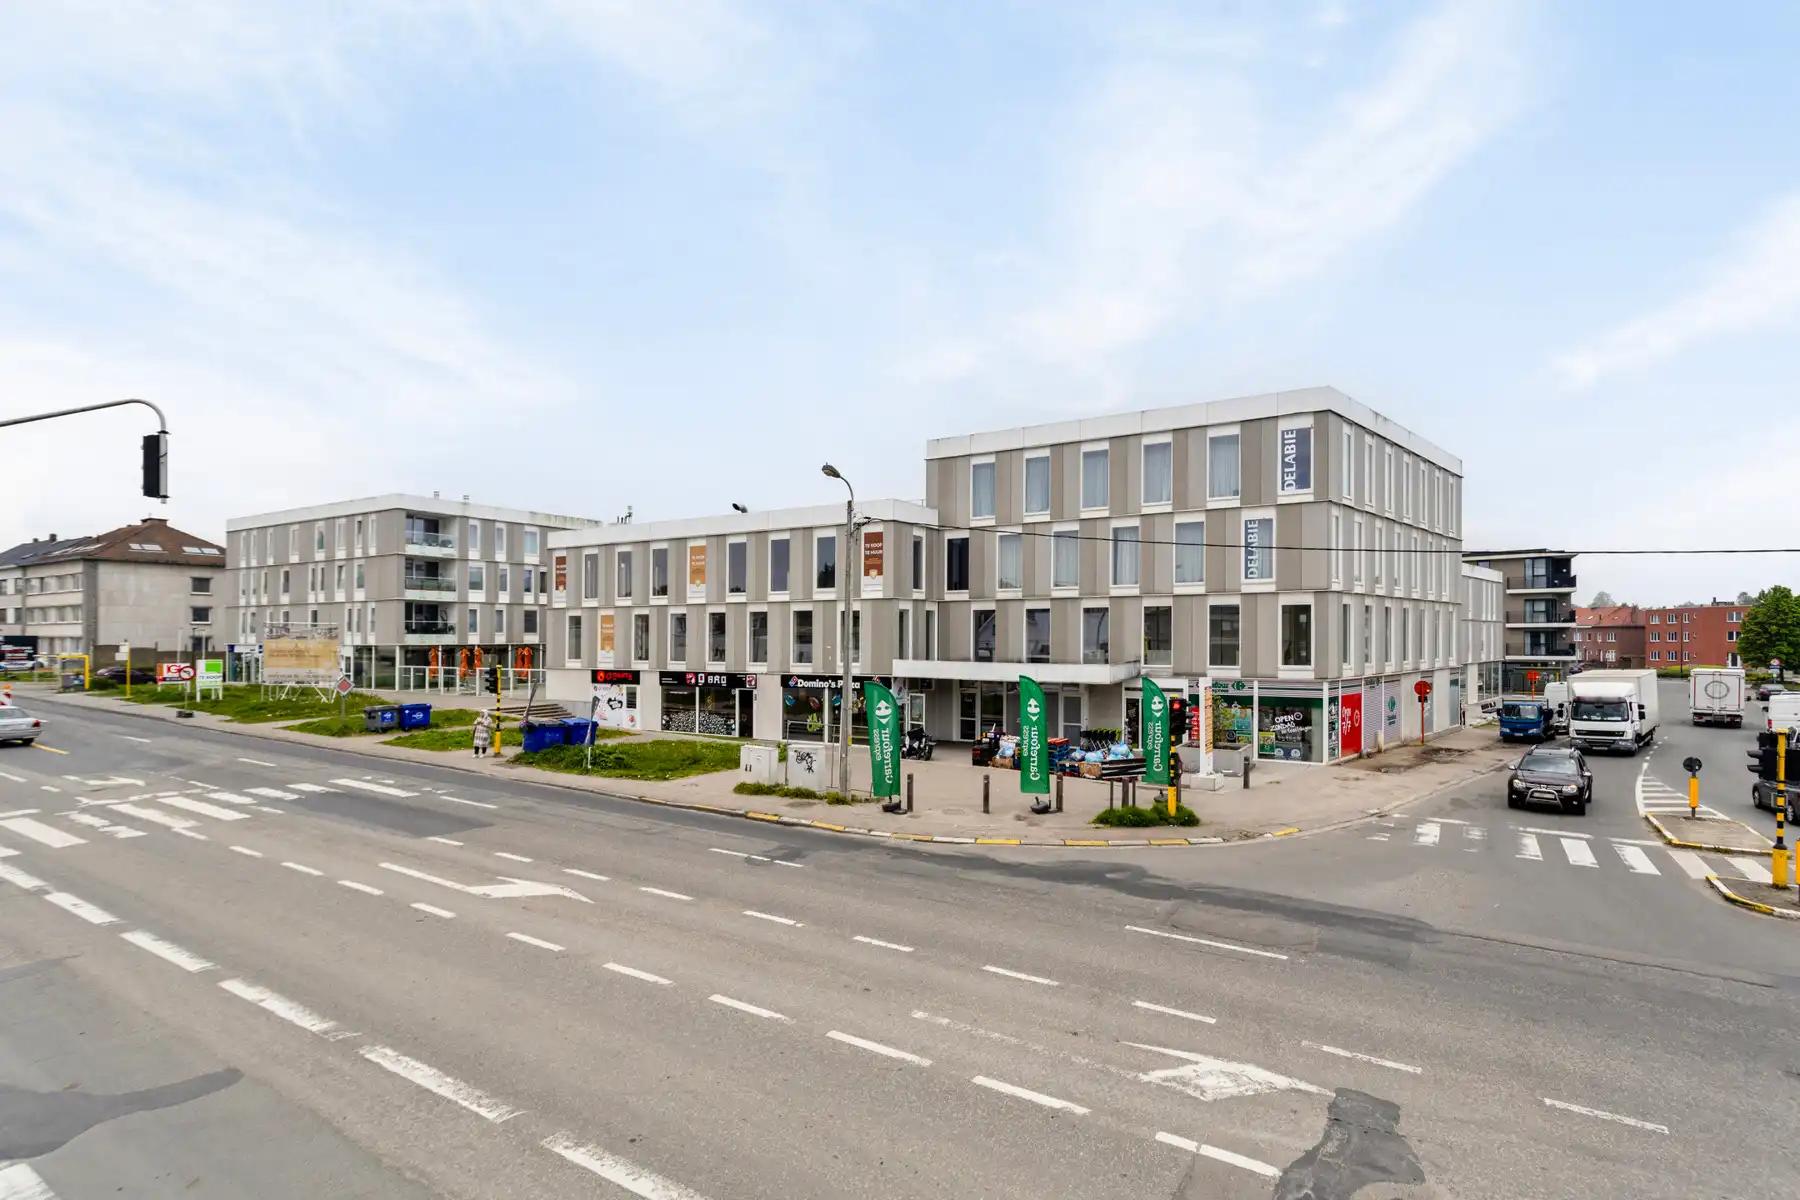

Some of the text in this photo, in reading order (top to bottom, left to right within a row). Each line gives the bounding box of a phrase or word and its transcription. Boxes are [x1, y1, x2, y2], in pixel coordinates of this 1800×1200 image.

[1284, 430, 1296, 491] DELABIE
[1247, 520, 1259, 578] DELABIE
[797, 679, 836, 689] Domino's
[1275, 714, 1295, 723] OPEN
